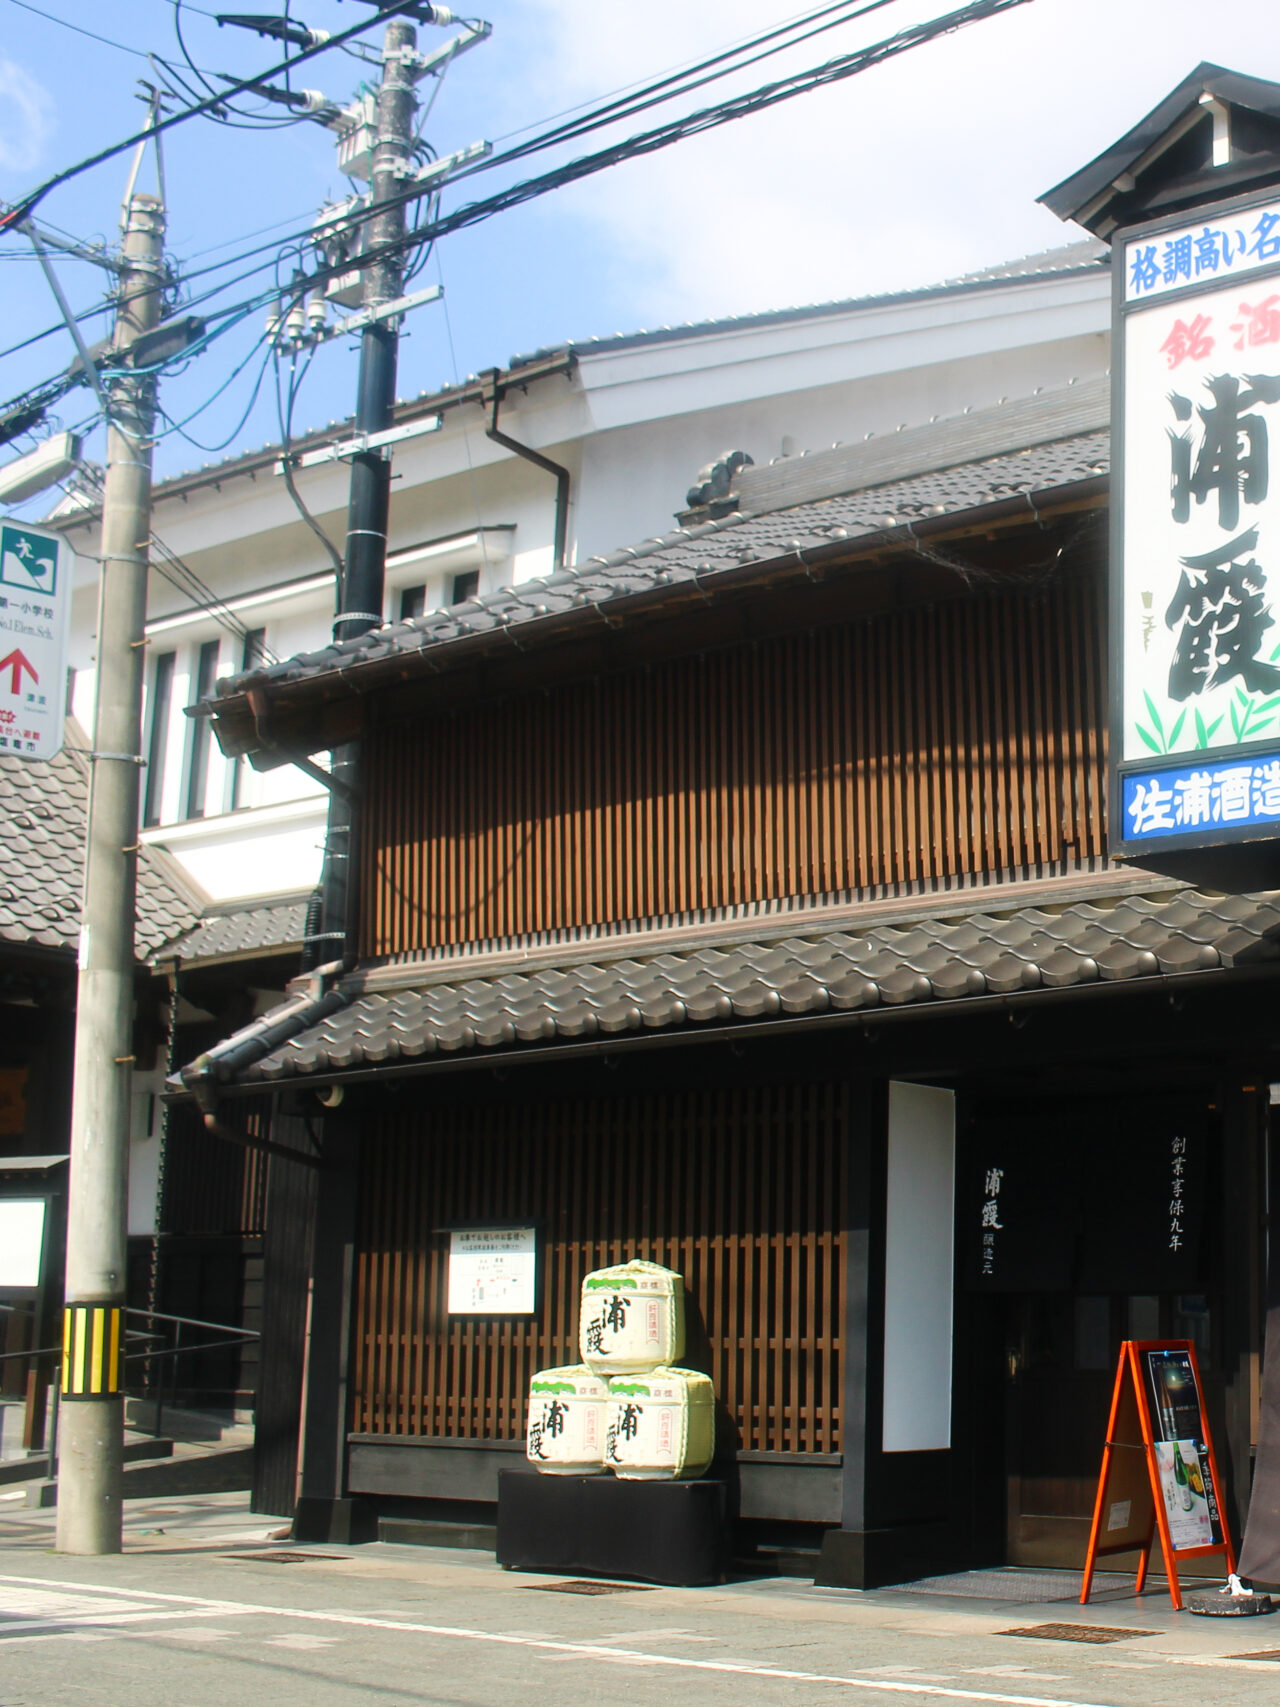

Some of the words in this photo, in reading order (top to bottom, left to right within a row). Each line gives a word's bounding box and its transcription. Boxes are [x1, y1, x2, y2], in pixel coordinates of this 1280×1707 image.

[982, 1167, 1004, 1230] 浦霞
[1168, 1136, 1187, 1252] 創業享保九年
[587, 1295, 632, 1355] 浦霞
[529, 1400, 570, 1461] 浦霞
[606, 1403, 643, 1463] 浦霞
